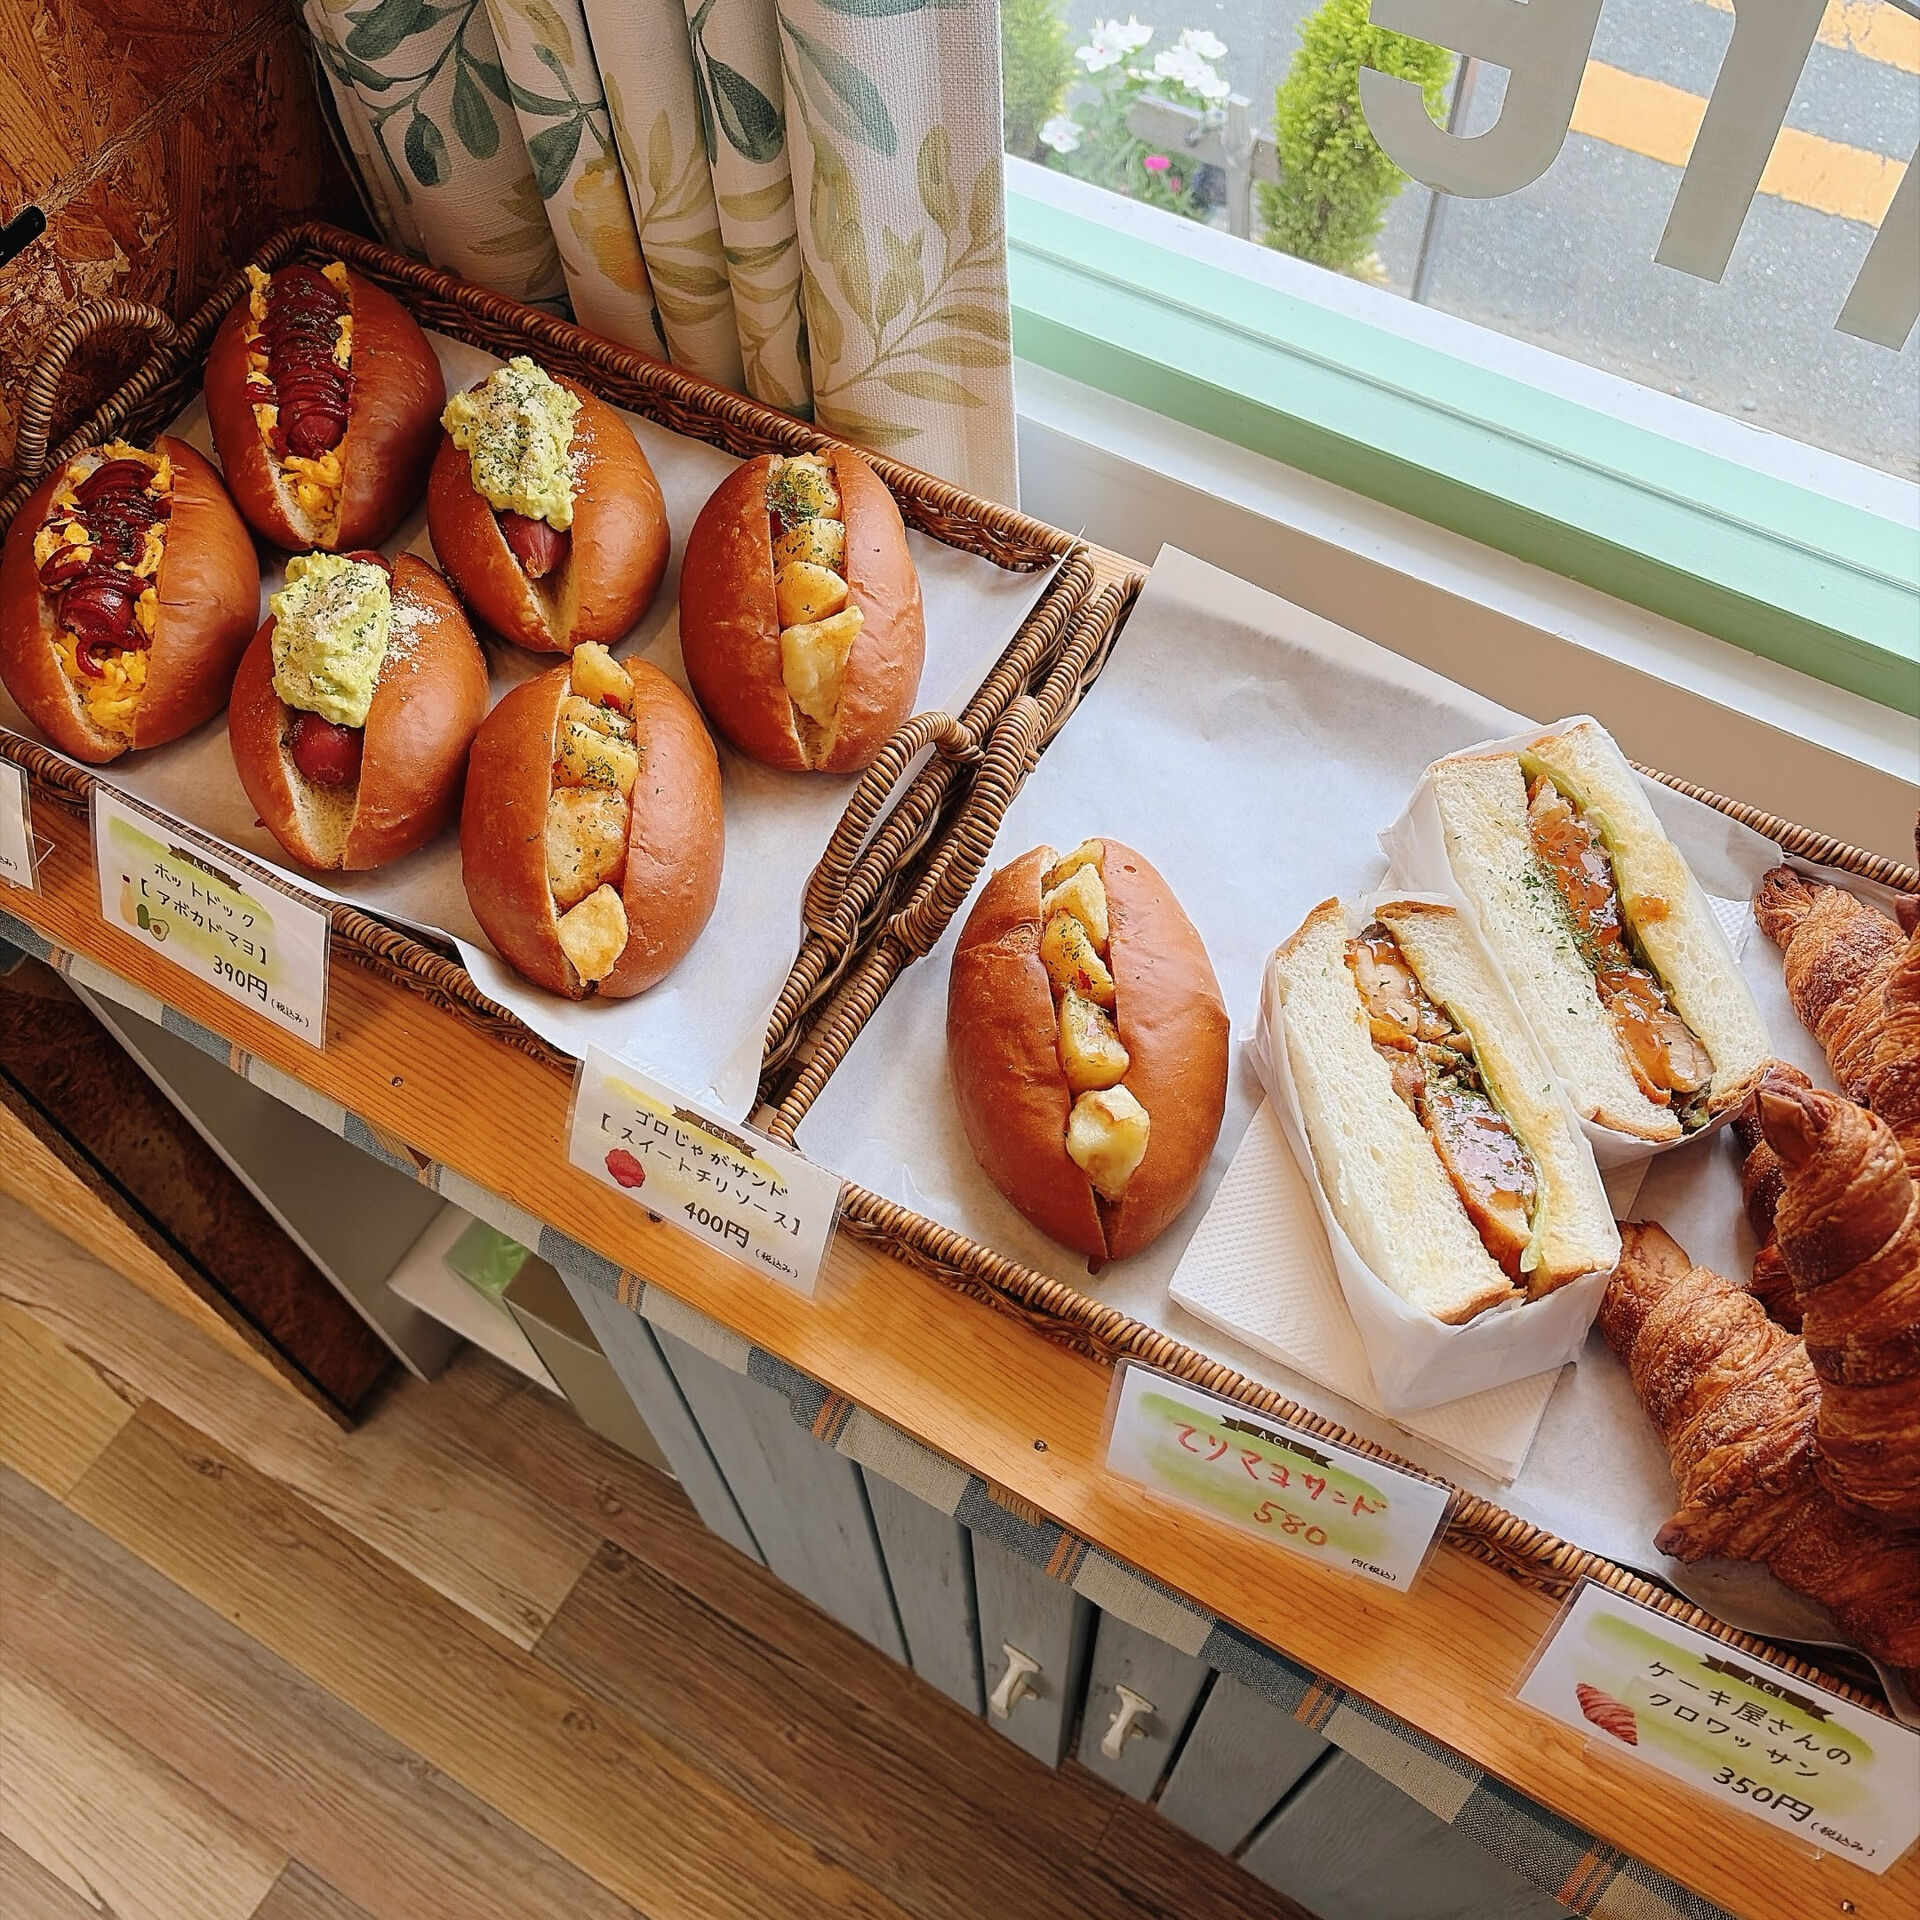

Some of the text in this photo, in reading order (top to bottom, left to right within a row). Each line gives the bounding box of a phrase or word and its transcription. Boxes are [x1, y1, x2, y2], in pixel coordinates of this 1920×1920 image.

[154, 863, 254, 929] ホットドック
[213, 955, 268, 1002] 390円
[635, 1109, 788, 1198] ゴロじゃがサンド
[684, 1201, 750, 1249] 400円
[1253, 1500, 1328, 1546] 580
[1647, 1660, 1852, 1766] ケーキ屋さんの
[1648, 1693, 1819, 1779] クロワッサン
[1713, 1766, 1814, 1822] 350円
